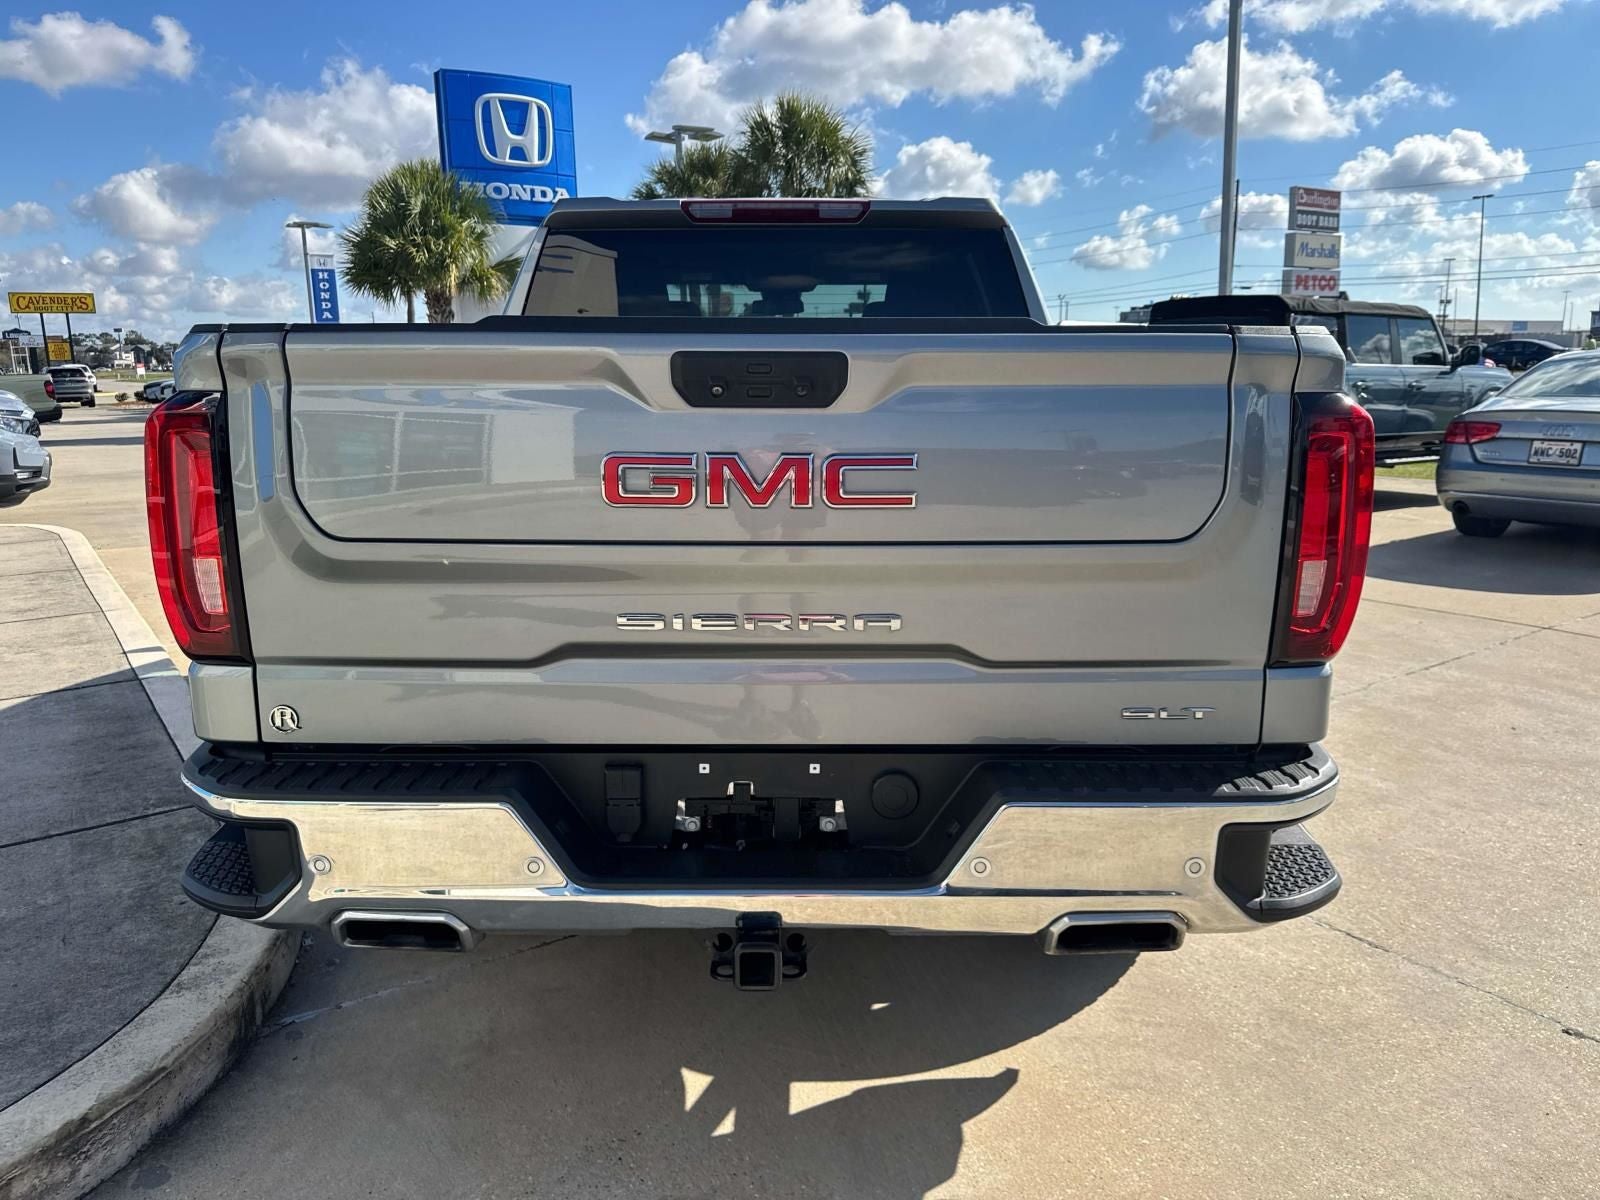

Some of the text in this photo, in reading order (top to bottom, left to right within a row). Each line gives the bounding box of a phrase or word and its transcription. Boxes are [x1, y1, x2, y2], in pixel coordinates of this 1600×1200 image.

[1295, 275, 1337, 291] PETCO
[16, 295, 89, 311] CAVENDER'S
[318, 271, 334, 319] HONDA
[600, 452, 918, 508] GMC
[616, 613, 902, 632] SIERRA
[1121, 706, 1216, 720] SLT
